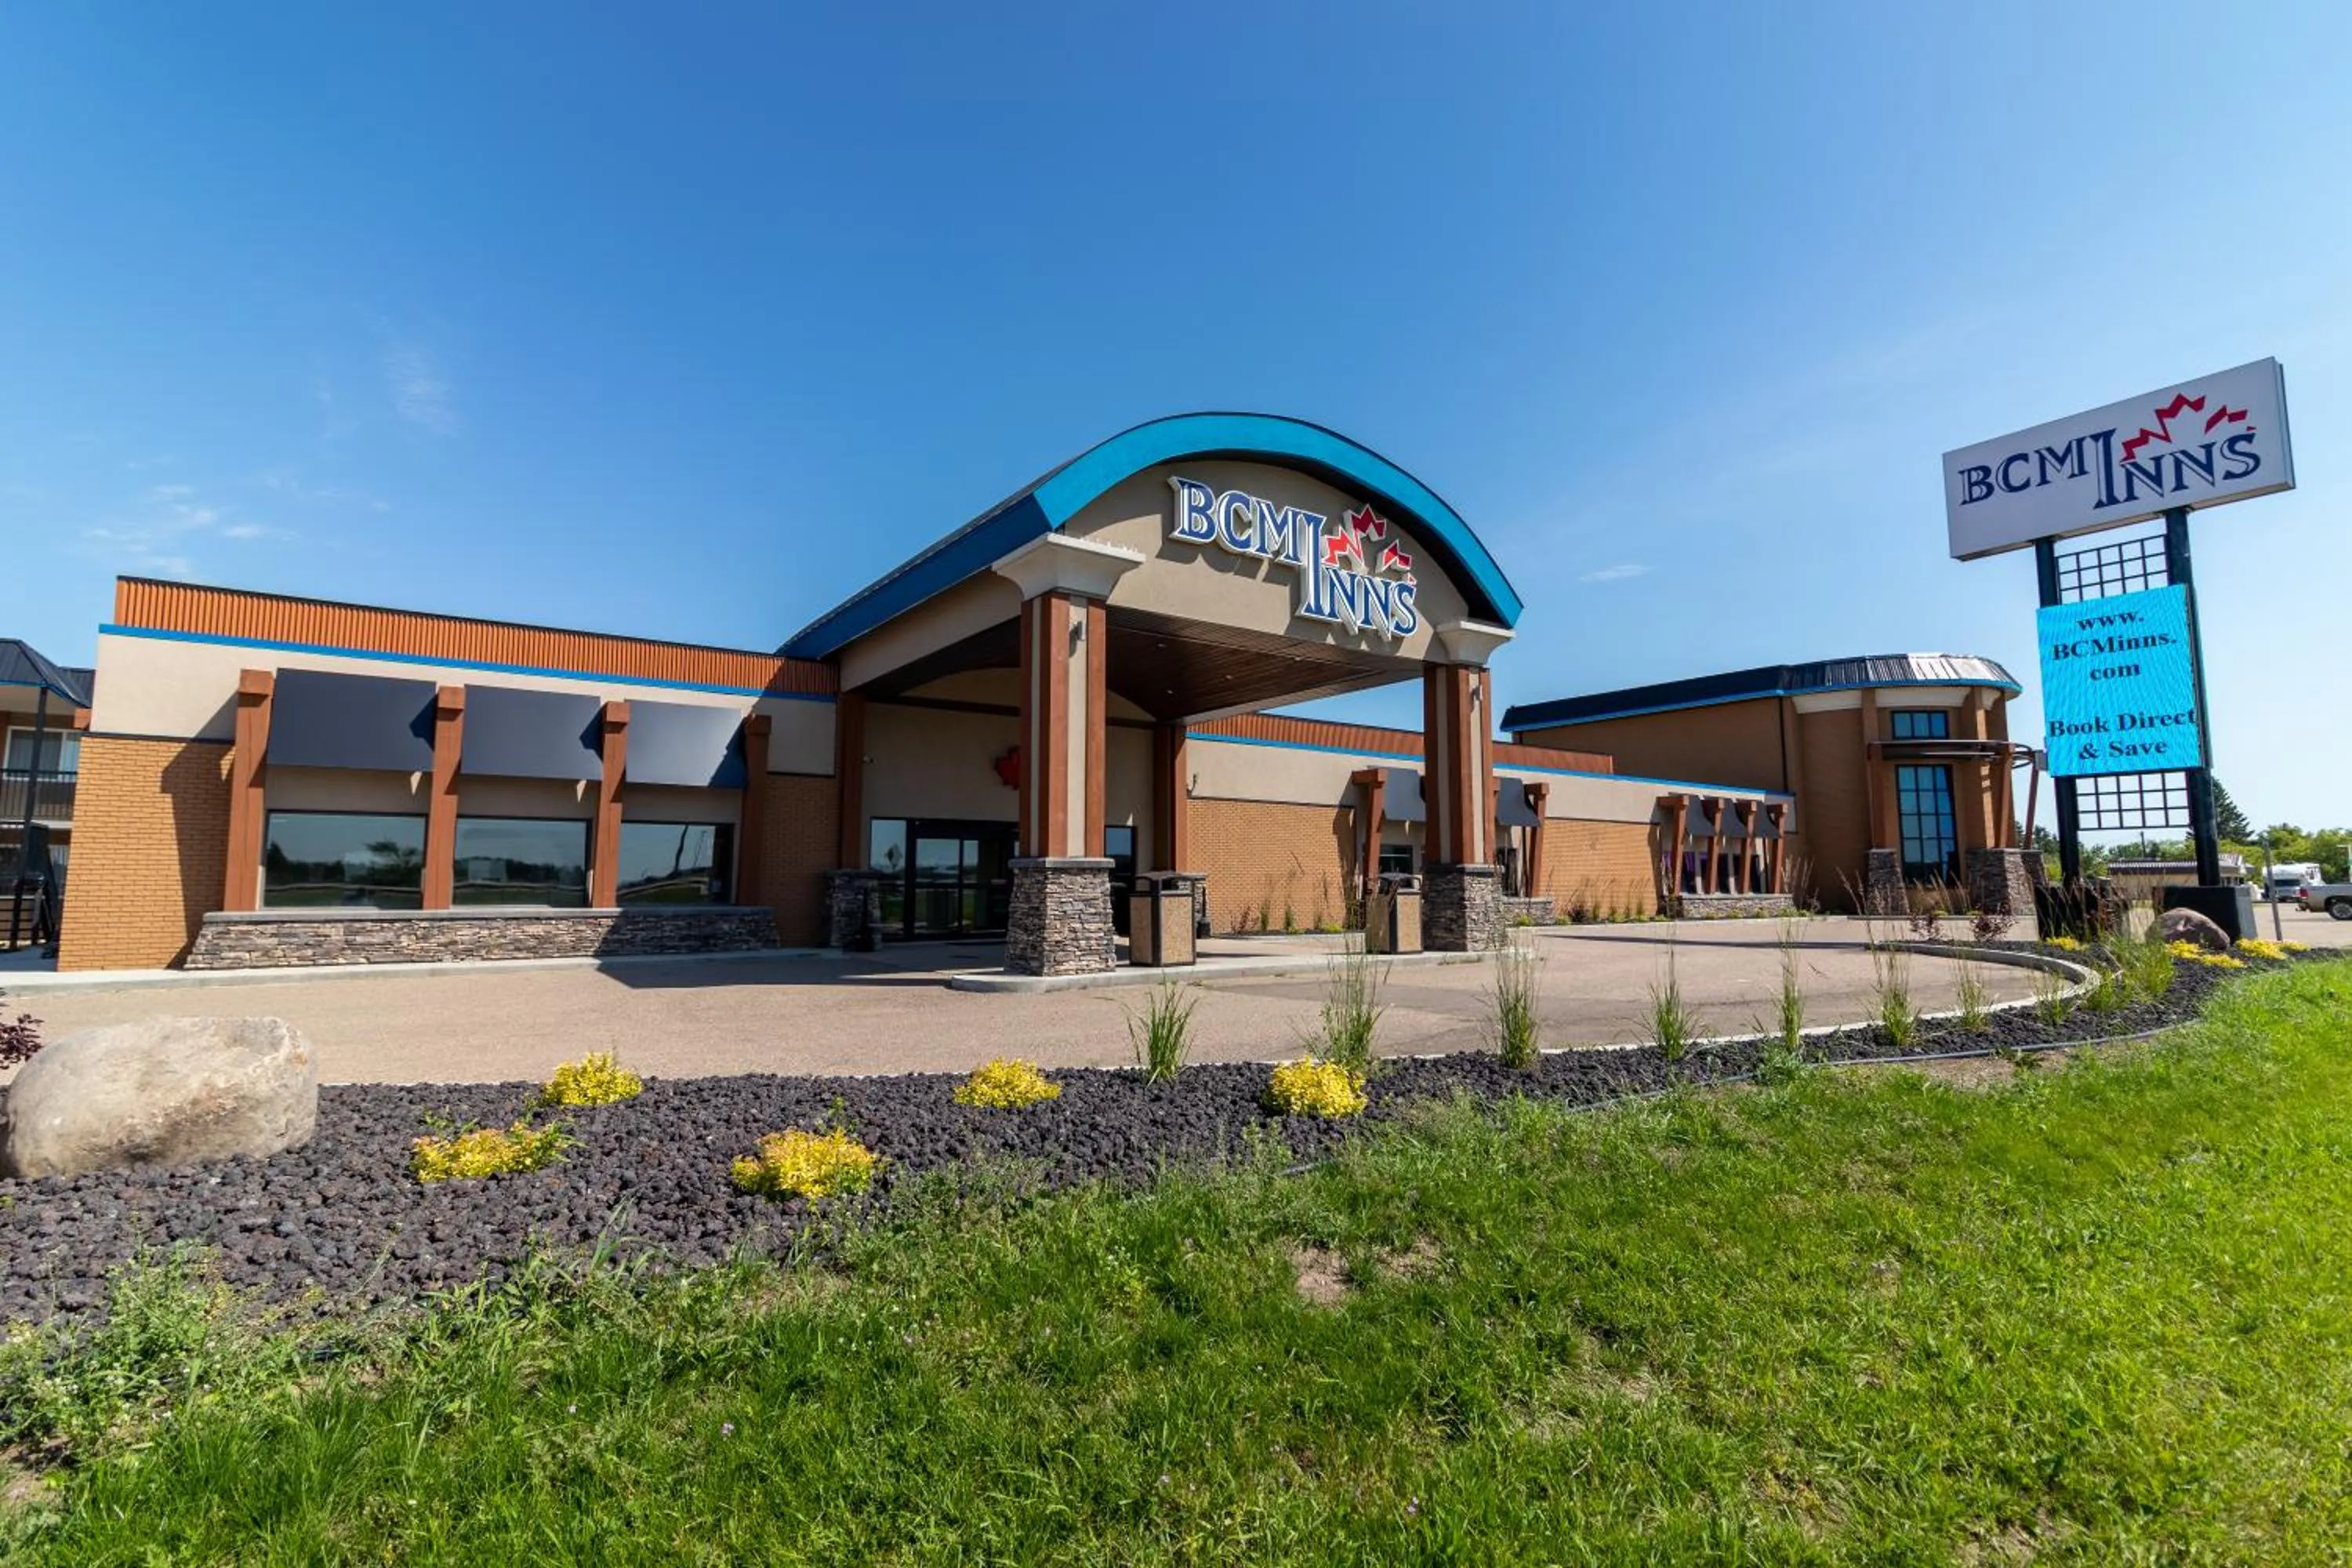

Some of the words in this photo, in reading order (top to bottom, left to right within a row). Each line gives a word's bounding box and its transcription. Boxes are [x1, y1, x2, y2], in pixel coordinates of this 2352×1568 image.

[2076, 612, 2144, 631] www.
[2053, 633, 2177, 661] BCMinns.
[2089, 664, 2140, 681] com
[2049, 716, 2110, 738] Book
[2118, 708, 2196, 731] Direct
[2079, 742, 2100, 760] &
[2109, 741, 2168, 758] Save
